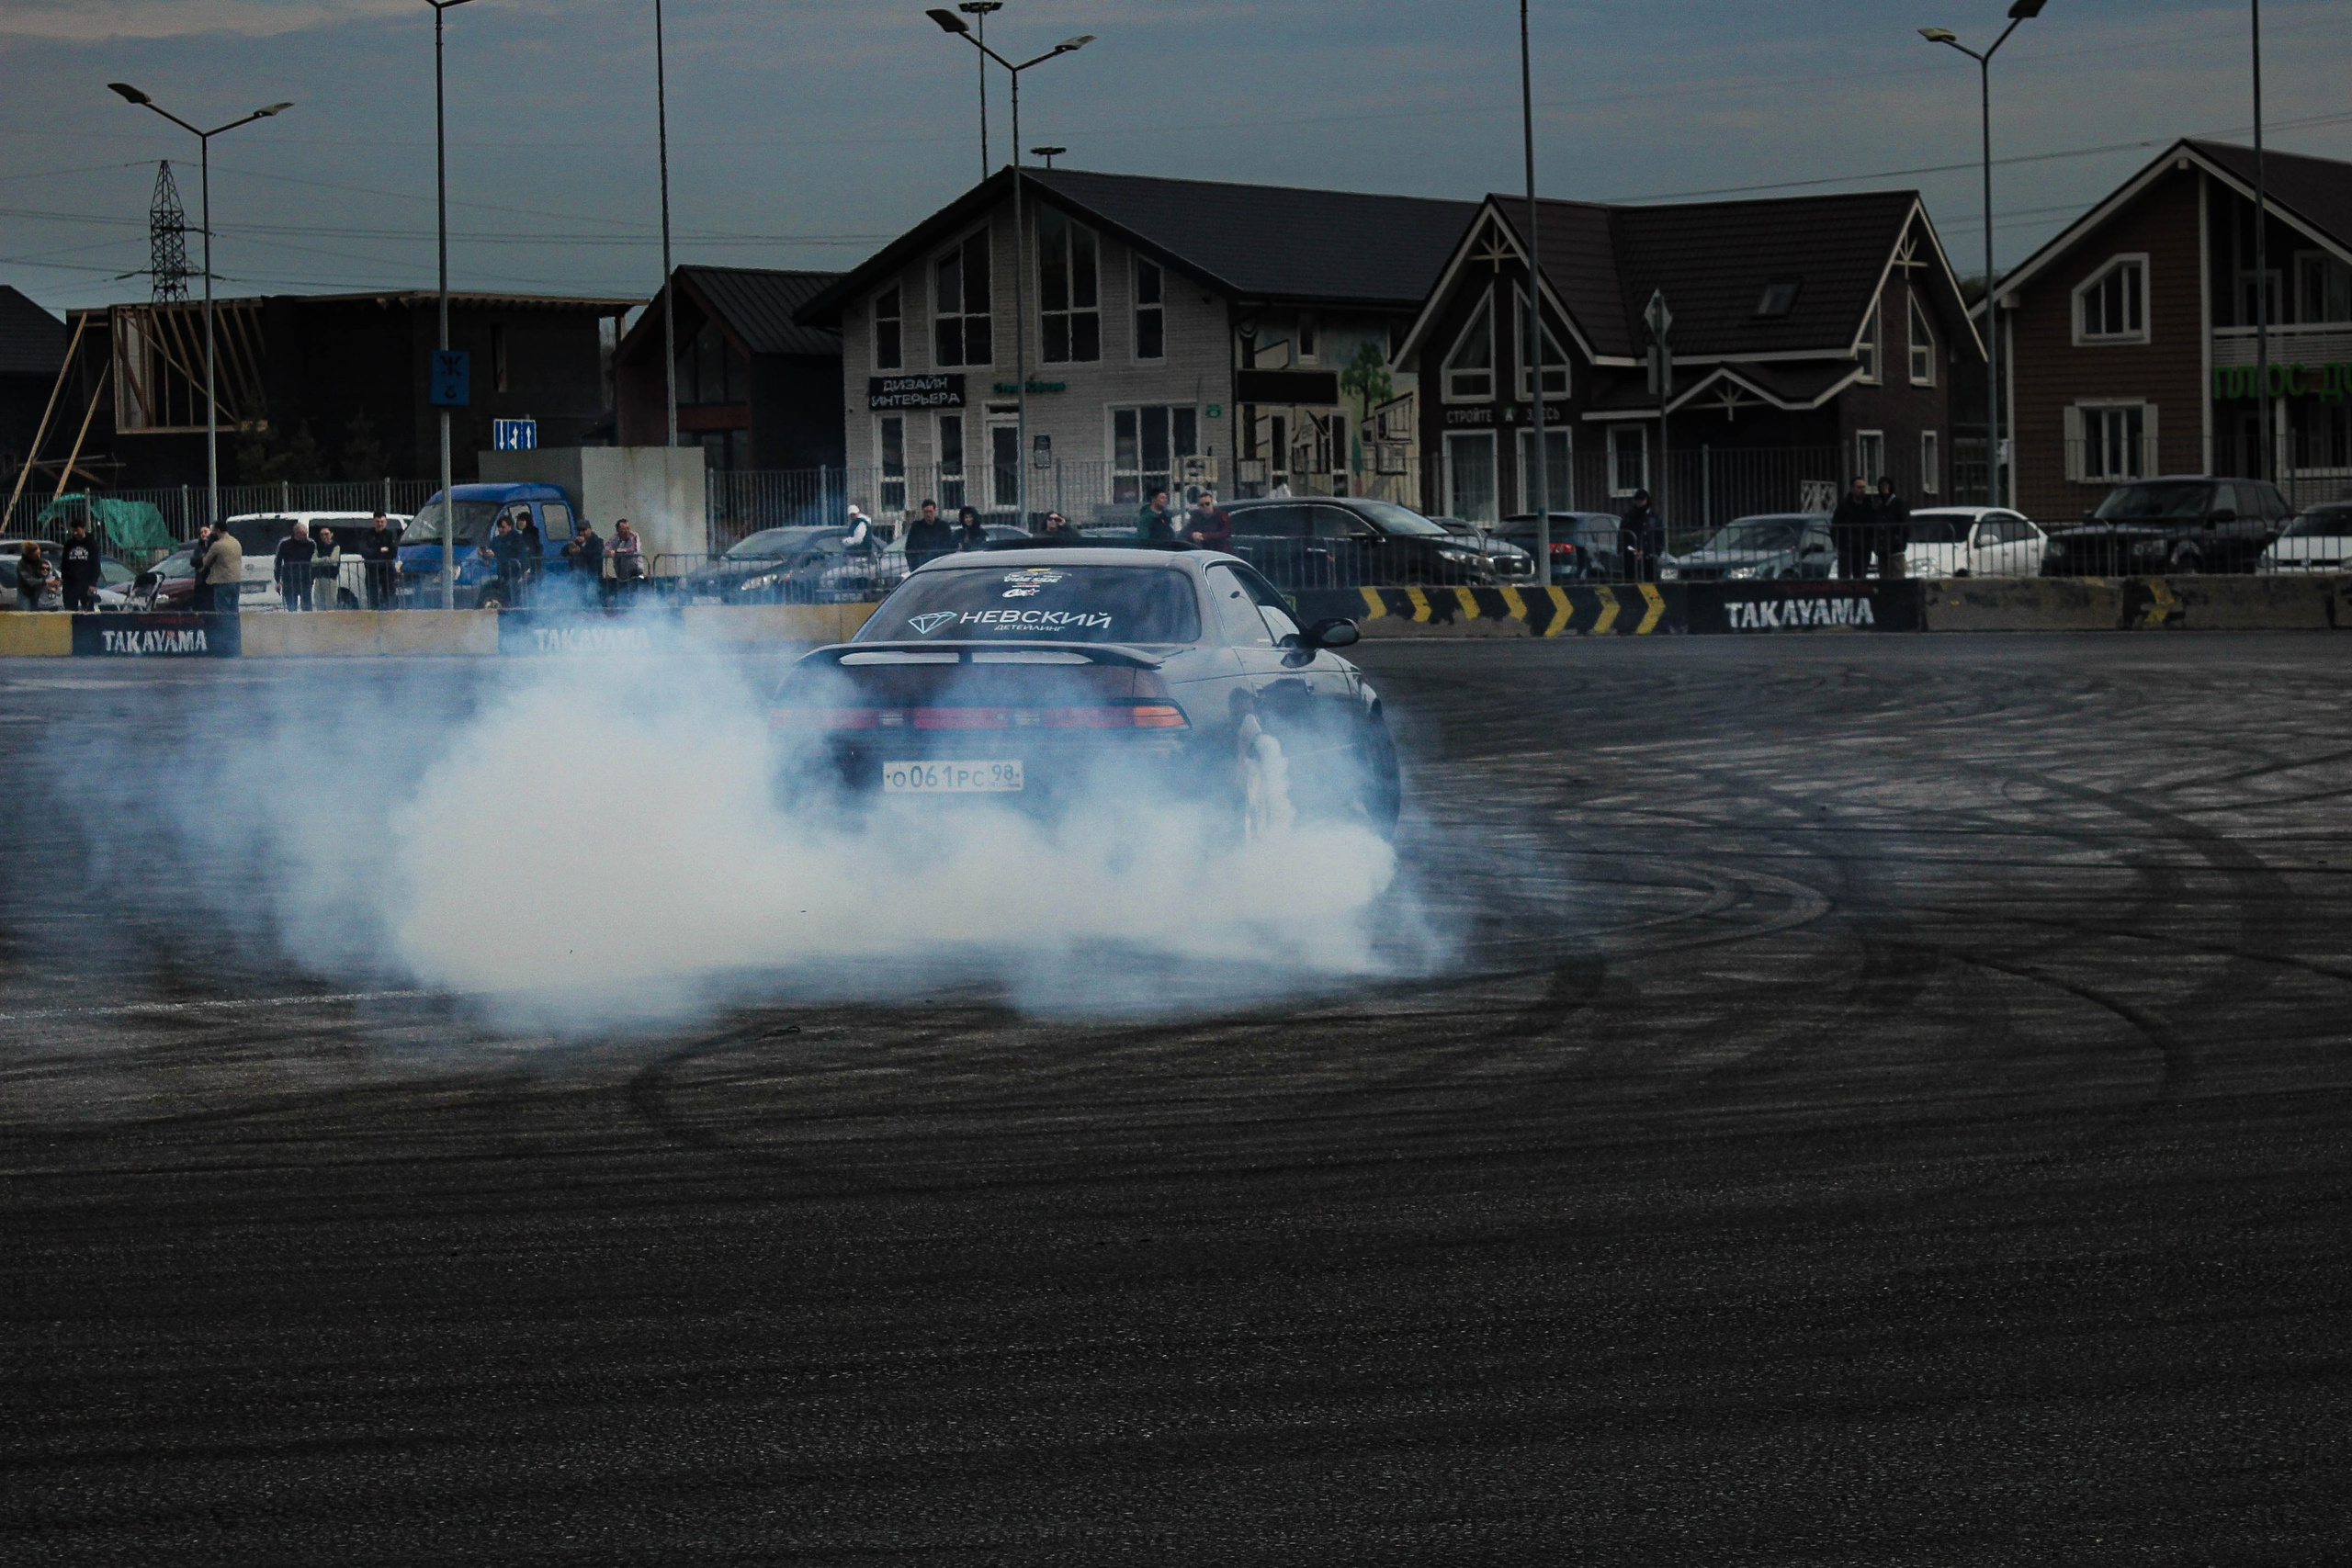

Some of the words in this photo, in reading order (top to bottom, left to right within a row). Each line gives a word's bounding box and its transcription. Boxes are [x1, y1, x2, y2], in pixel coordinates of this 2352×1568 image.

[883, 376, 947, 392] ДИЗАЙН
[871, 392, 960, 407] ИНТЕРЬЕРА
[1446, 407, 1493, 423] СТРОЙТЕ
[1526, 406, 1560, 421] ЗЕСЬ
[959, 610, 1112, 629] НЕВСКИЙ
[1724, 597, 1874, 628] TAKAYAMA
[993, 624, 1066, 632] ДЕТЕЙЛИНГ
[102, 629, 207, 653] TAKAYAMA
